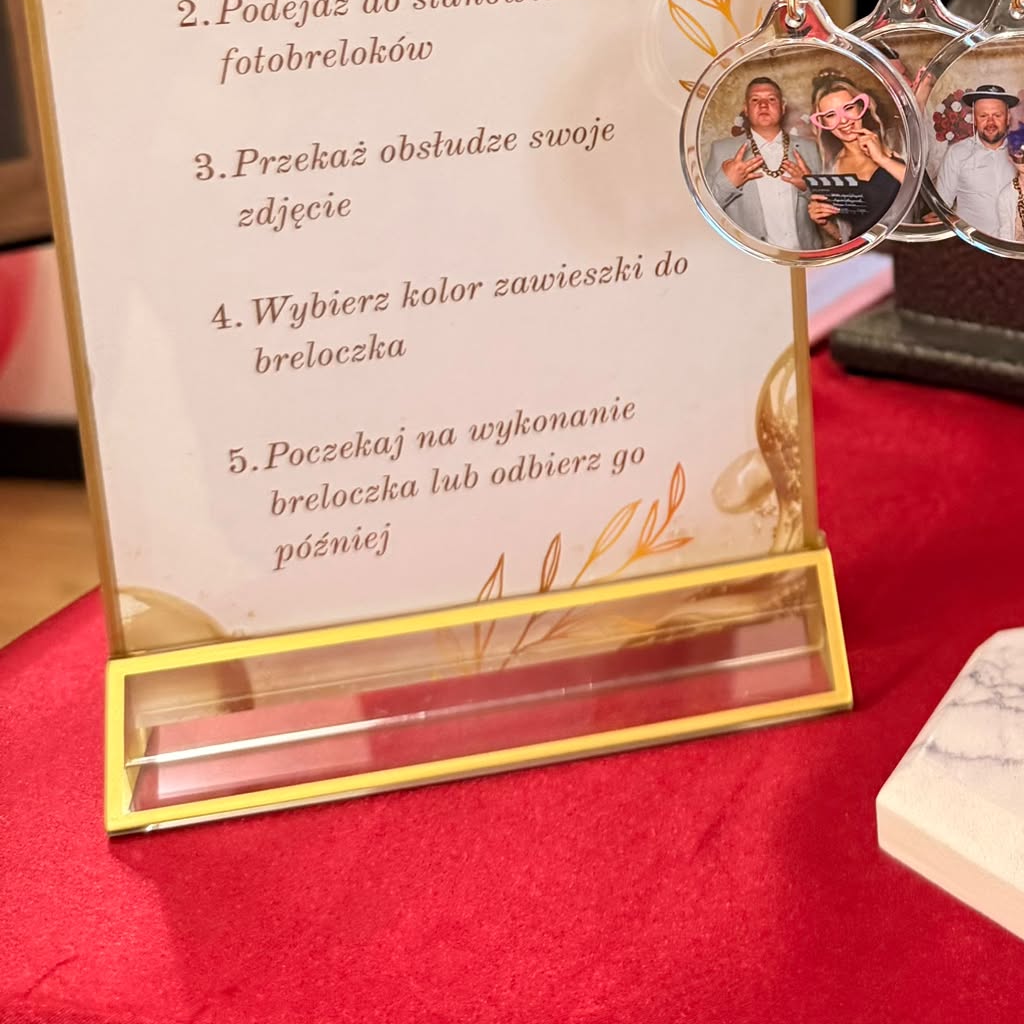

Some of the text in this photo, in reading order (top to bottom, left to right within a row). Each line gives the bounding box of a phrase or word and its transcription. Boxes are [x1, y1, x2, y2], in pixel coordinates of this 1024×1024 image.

[219, 35, 434, 86] fotobreloków
[379, 126, 518, 164] obsłudze
[528, 116, 615, 152] swoje
[237, 191, 352, 233] zdjęcie
[401, 276, 484, 309] kolor
[493, 253, 644, 298] zawieszki
[654, 249, 689, 278] do
[254, 333, 407, 375] breloczka
[416, 427, 457, 449] na
[468, 396, 636, 446] wykonanie
[270, 446, 646, 517] breloczka lub odbierz go
[272, 522, 391, 572] później
